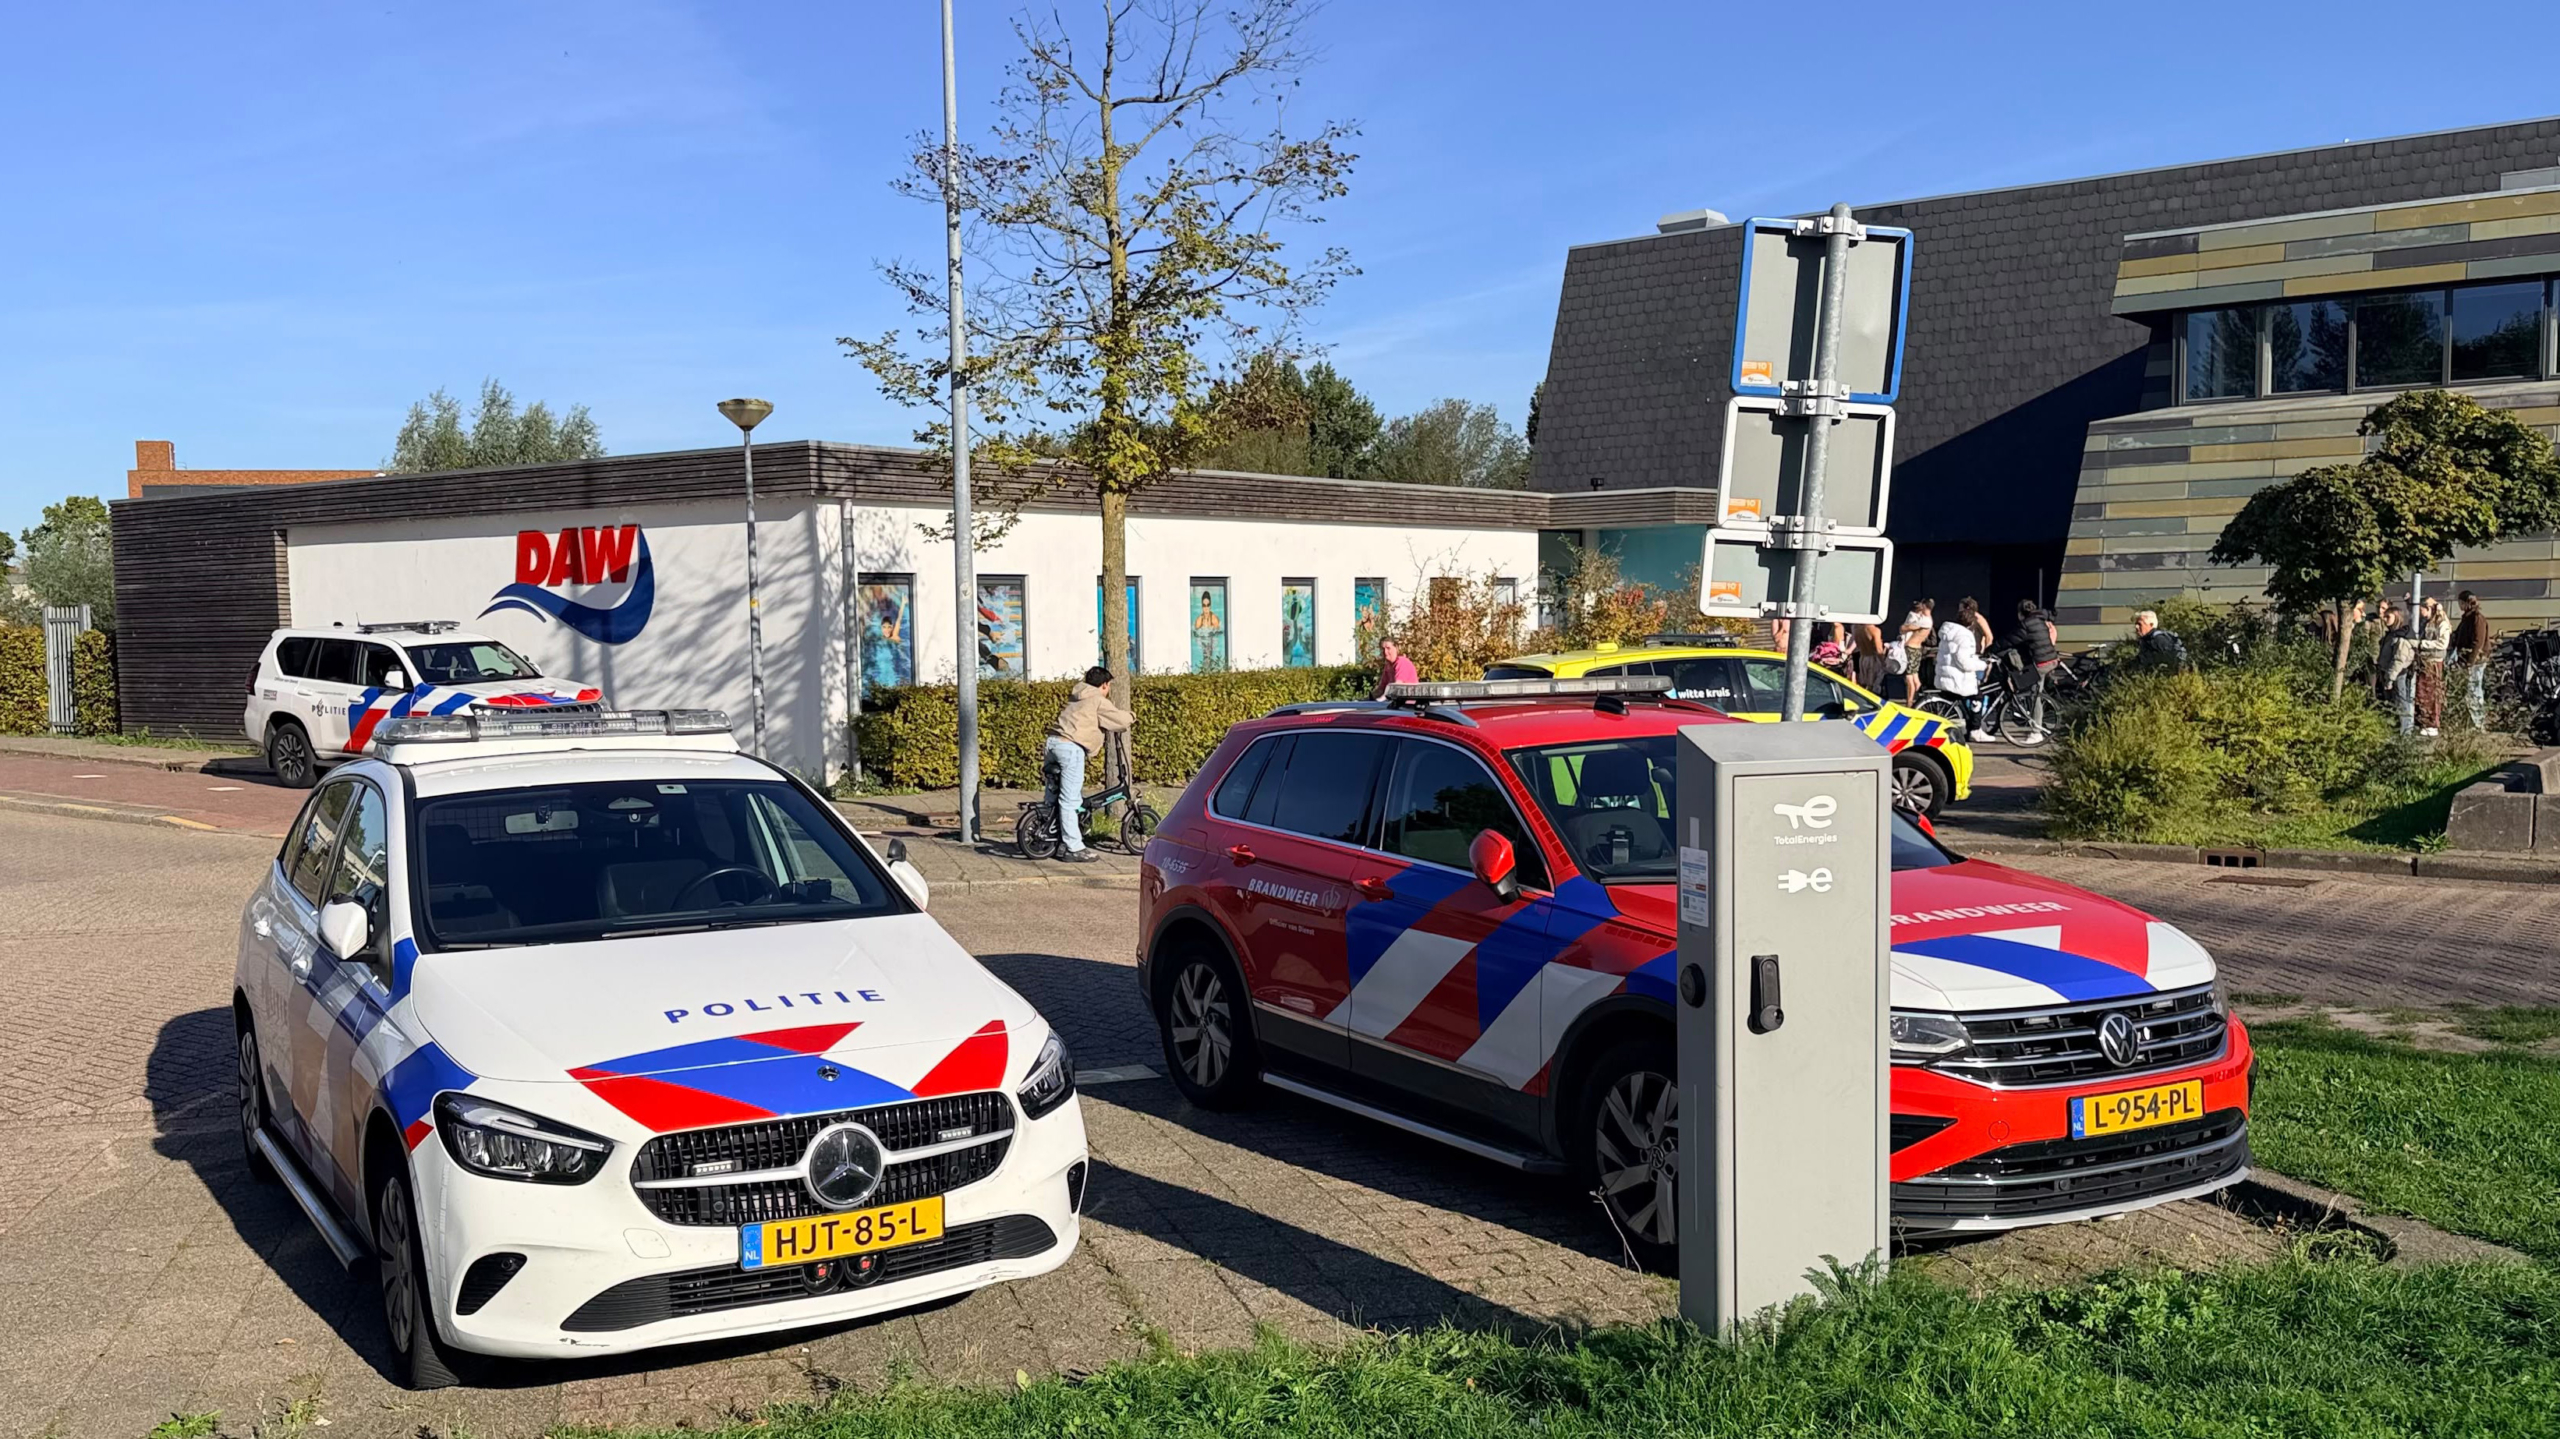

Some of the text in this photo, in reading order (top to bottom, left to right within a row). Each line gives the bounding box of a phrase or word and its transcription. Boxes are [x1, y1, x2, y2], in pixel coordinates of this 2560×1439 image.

[515, 524, 637, 587] DAW
[1678, 687, 1731, 699] witte kruis
[1773, 833, 1838, 845] TotalEnergies
[1248, 878, 1318, 907] BRANDWEER
[663, 989, 886, 1024] POLITIE
[2094, 1087, 2195, 1129] L-954-PL
[2073, 1121, 2084, 1132] NL
[776, 1206, 927, 1258] HJT-85-L
[744, 1249, 760, 1262] NL
